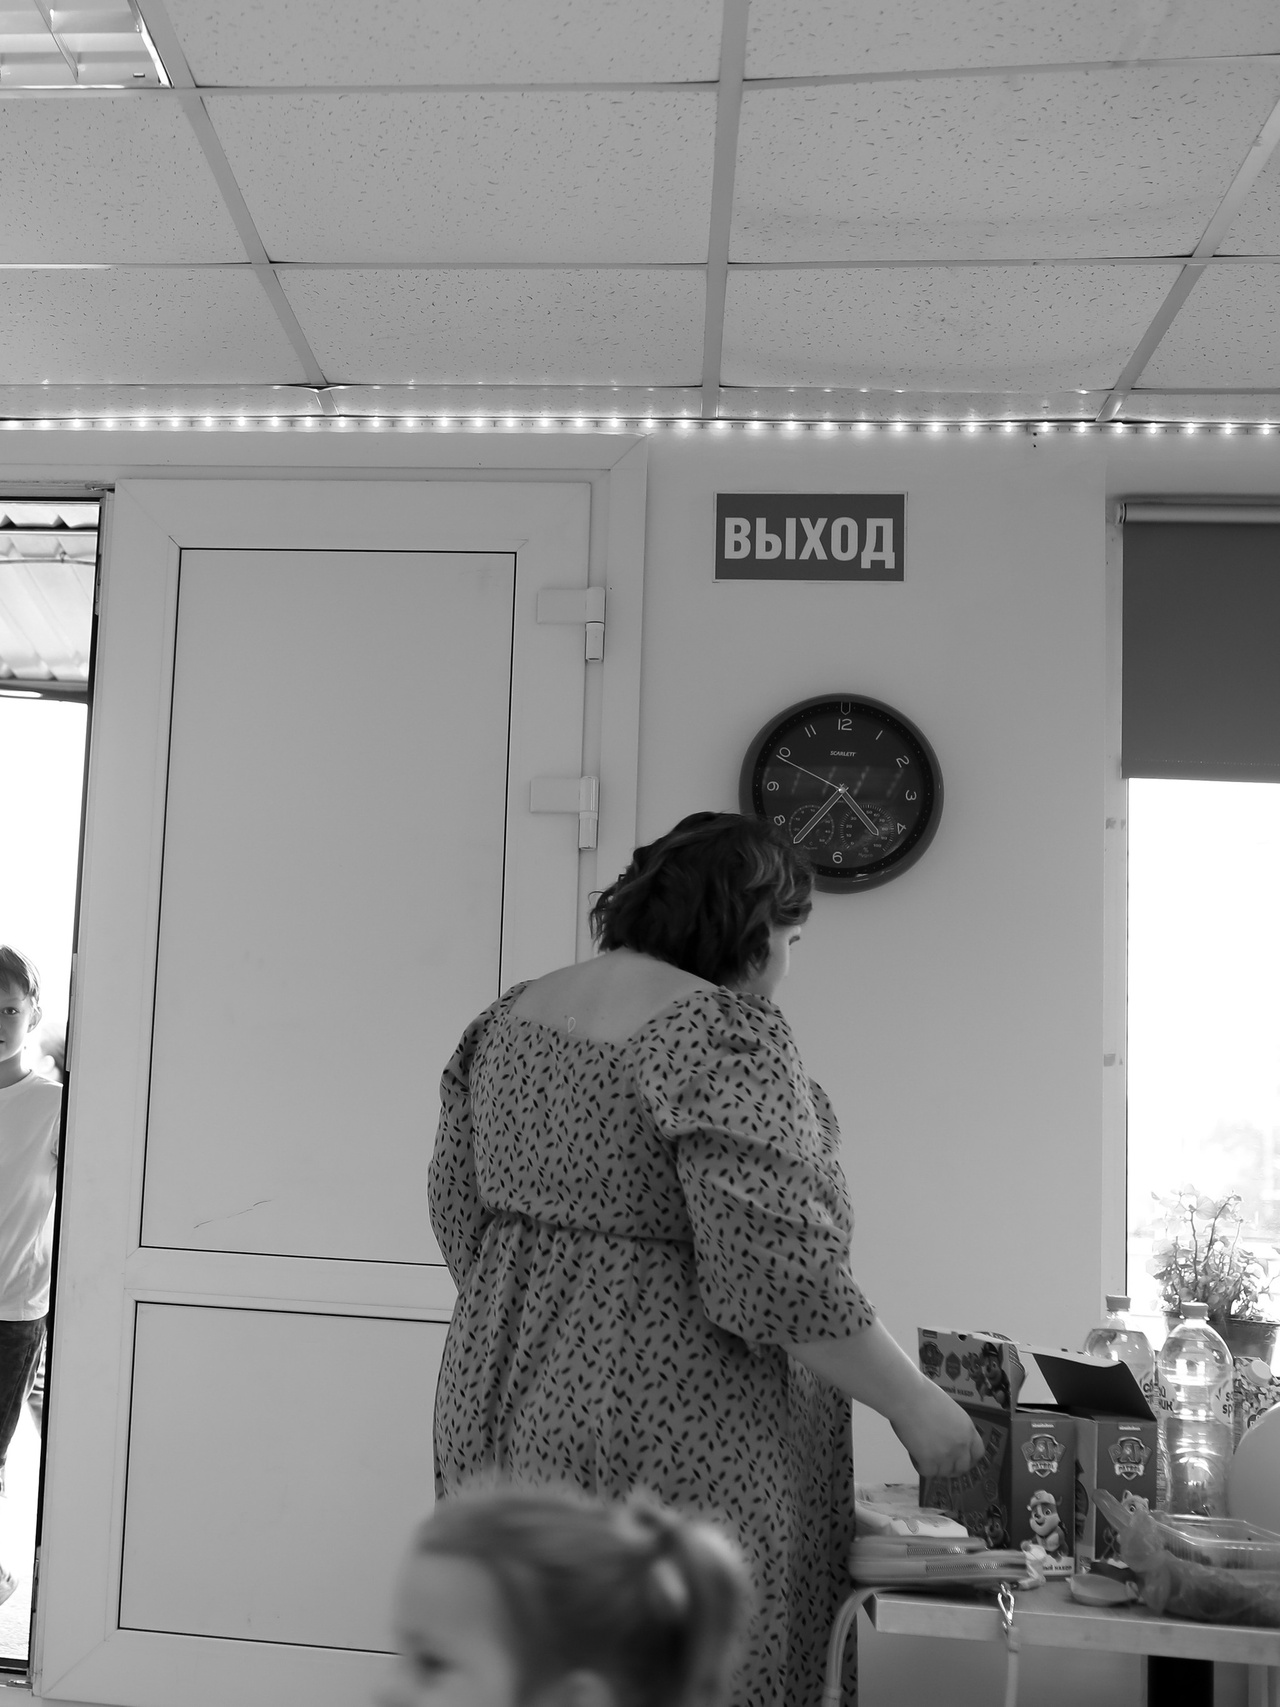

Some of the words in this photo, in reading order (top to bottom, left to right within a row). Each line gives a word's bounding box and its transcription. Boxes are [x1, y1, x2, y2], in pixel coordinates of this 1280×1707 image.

[724, 516, 896, 570] ВЫХОД
[804, 723, 817, 738] 11
[837, 718, 853, 731] 12
[875, 729, 883, 741] 1
[895, 754, 910, 768] 2
[766, 780, 780, 792] 9
[905, 789, 917, 801] 3
[773, 814, 786, 826] 8
[896, 821, 907, 835] 4
[832, 851, 843, 864] 6
